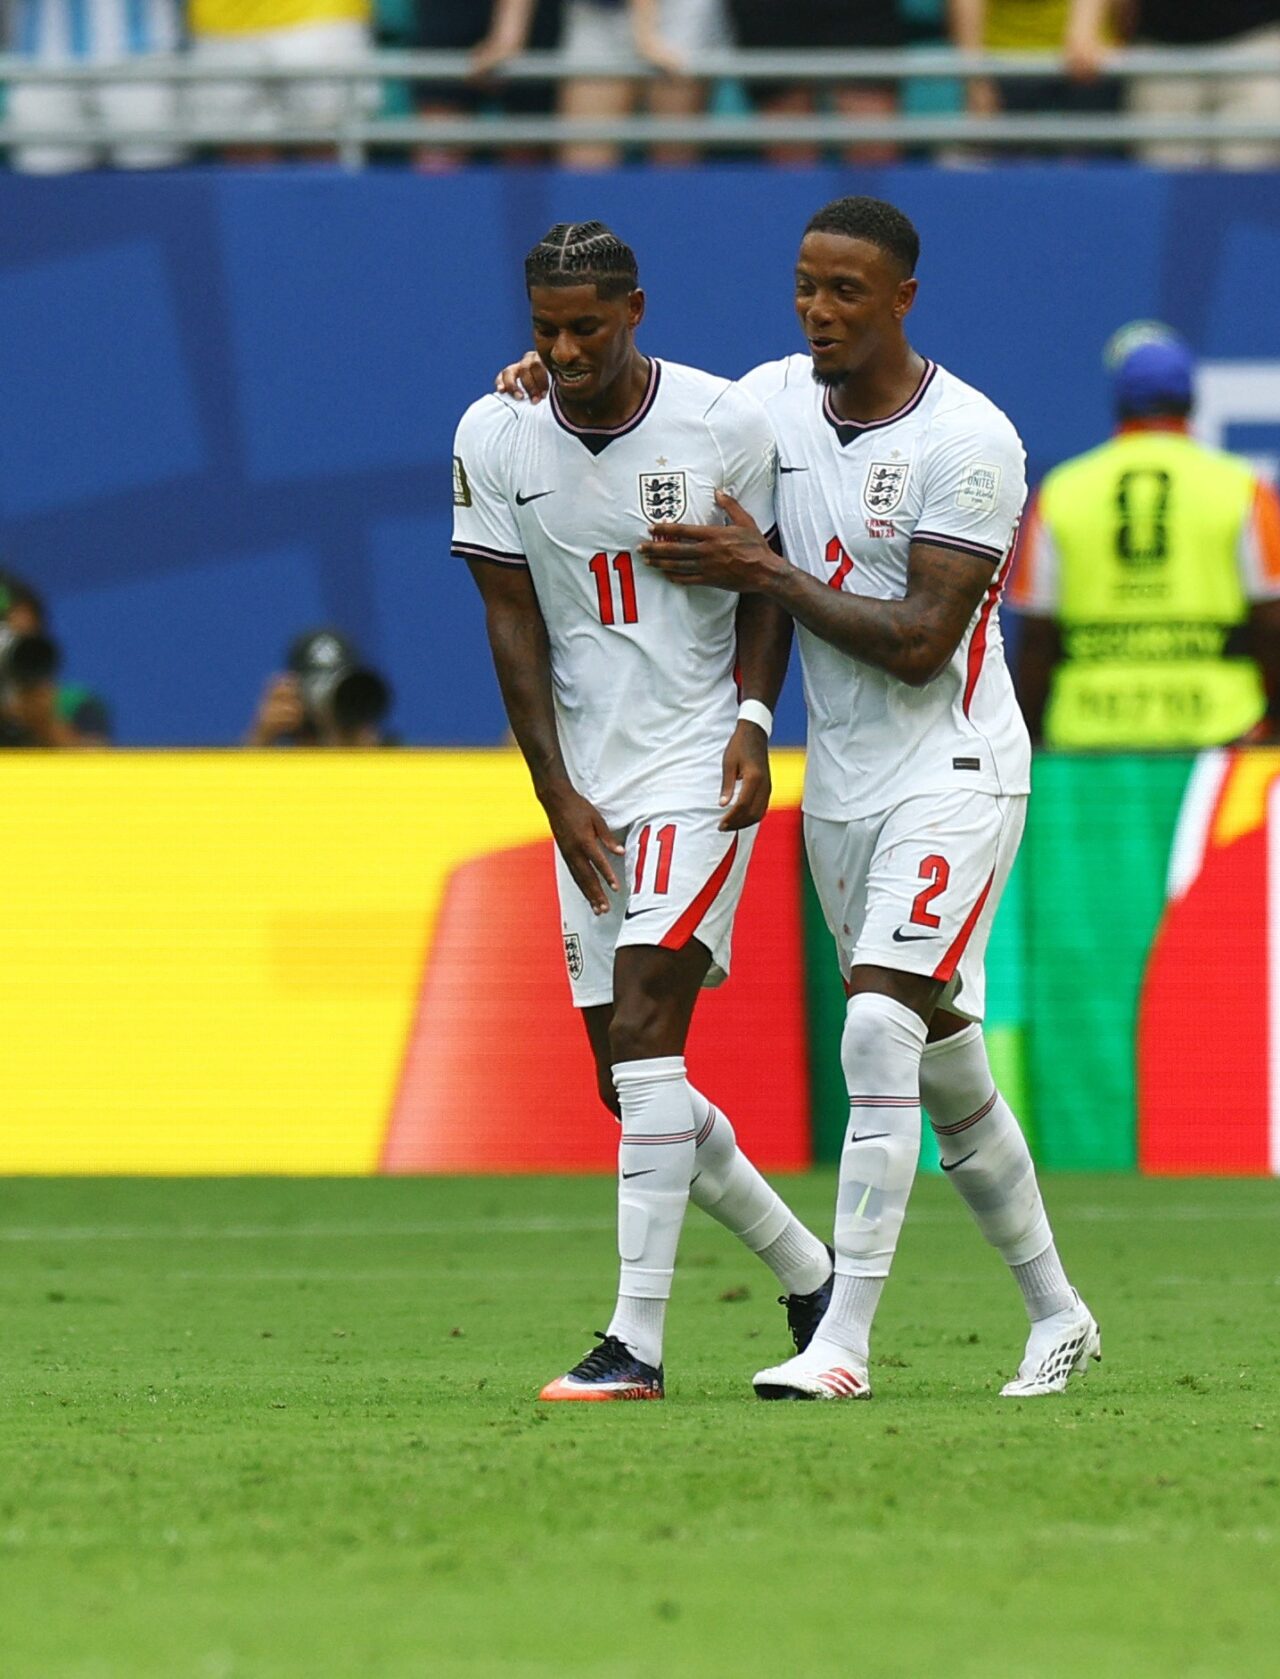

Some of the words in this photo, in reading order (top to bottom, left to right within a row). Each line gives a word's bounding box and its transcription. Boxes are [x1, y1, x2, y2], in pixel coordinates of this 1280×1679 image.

[588, 551, 638, 625] 11
[825, 534, 854, 590] 2
[633, 824, 677, 895] 11
[909, 854, 951, 929] 2
